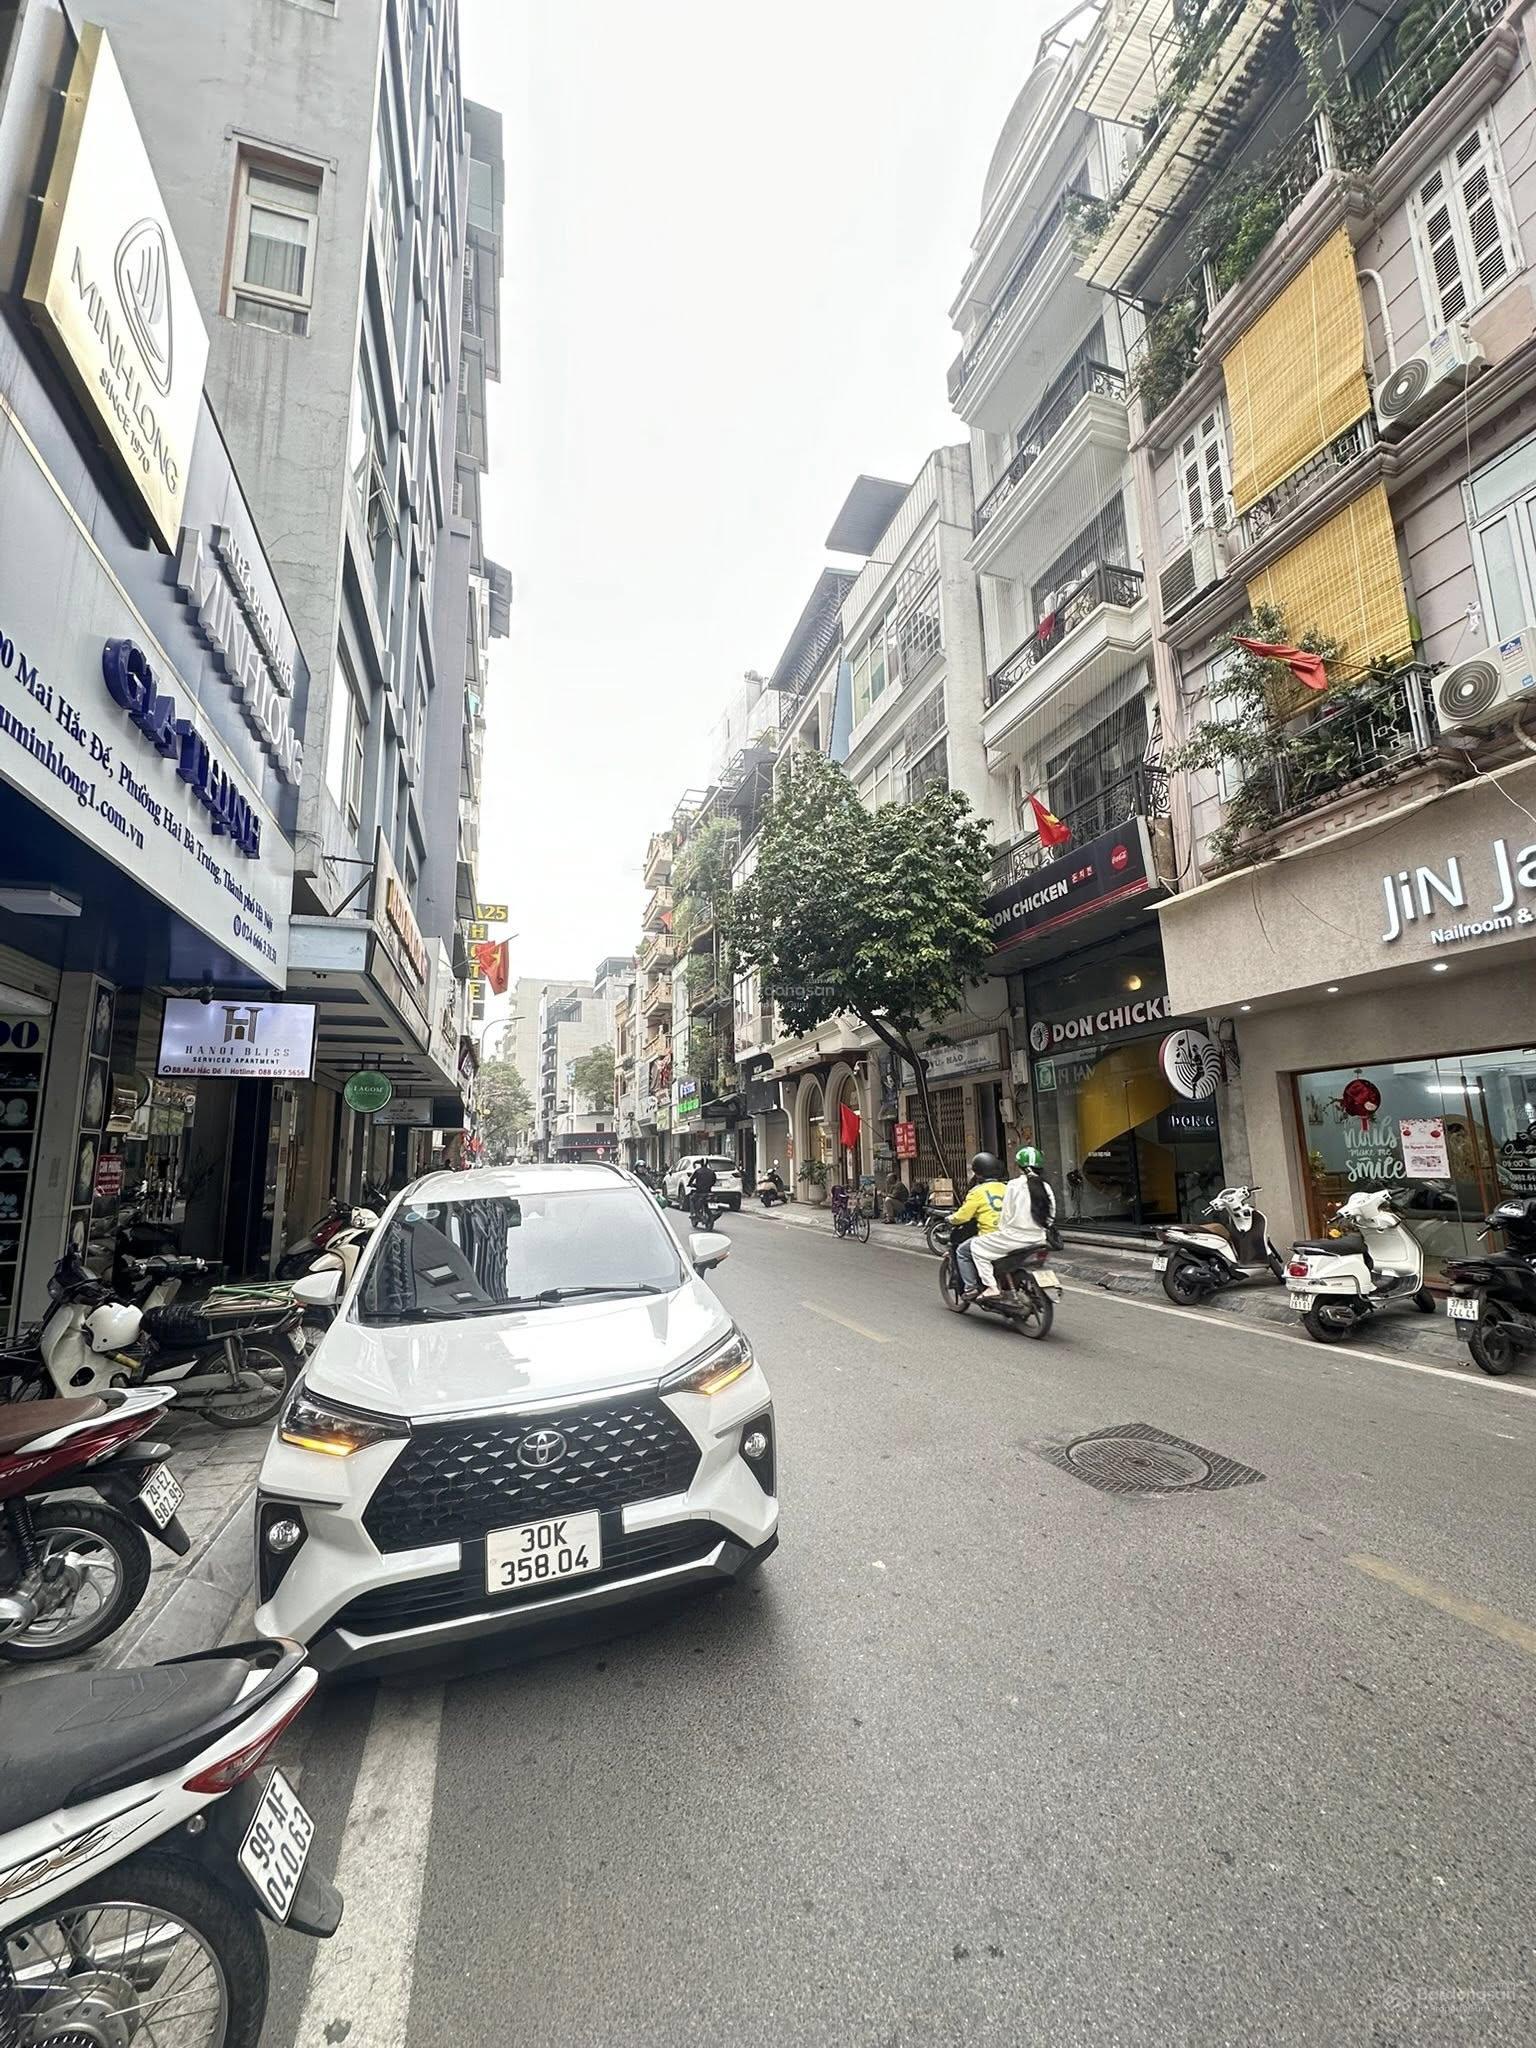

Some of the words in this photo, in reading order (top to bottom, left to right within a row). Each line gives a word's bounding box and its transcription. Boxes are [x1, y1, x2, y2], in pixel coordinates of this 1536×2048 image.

[99, 367, 130, 435] SINCE
[129, 430, 150, 474] 1970
[15, 652, 54, 714] Mai
[56, 695, 88, 748] Hắc
[119, 760, 160, 826] Phường
[163, 808, 182, 843] Hai
[184, 830, 196, 858] Bà
[1012, 879, 1069, 919] CHICKEN
[1382, 856, 1465, 942] JiN
[1430, 915, 1513, 944] Nailroom
[1516, 907, 1535, 924] &
[1052, 1014, 1094, 1043] DON
[185, 1045, 235, 1057] HANOI
[244, 1046, 291, 1057] BLISS
[192, 1056, 232, 1064] SERVICED
[234, 1057, 280, 1065] APARTMENT
[182, 1066, 196, 1074] Mai
[353, 1084, 384, 1093] LAGOM
[1344, 1115, 1398, 1149] nails
[1345, 1156, 1407, 1183] smile
[1350, 1148, 1375, 1157] make
[1377, 1148, 1393, 1156] me
[154, 1482, 183, 1525] 982.95
[520, 1520, 568, 1553] 30K
[500, 1544, 590, 1587] 358.04
[249, 1781, 289, 1870] 99-AF
[266, 1805, 312, 1912] 040.63
